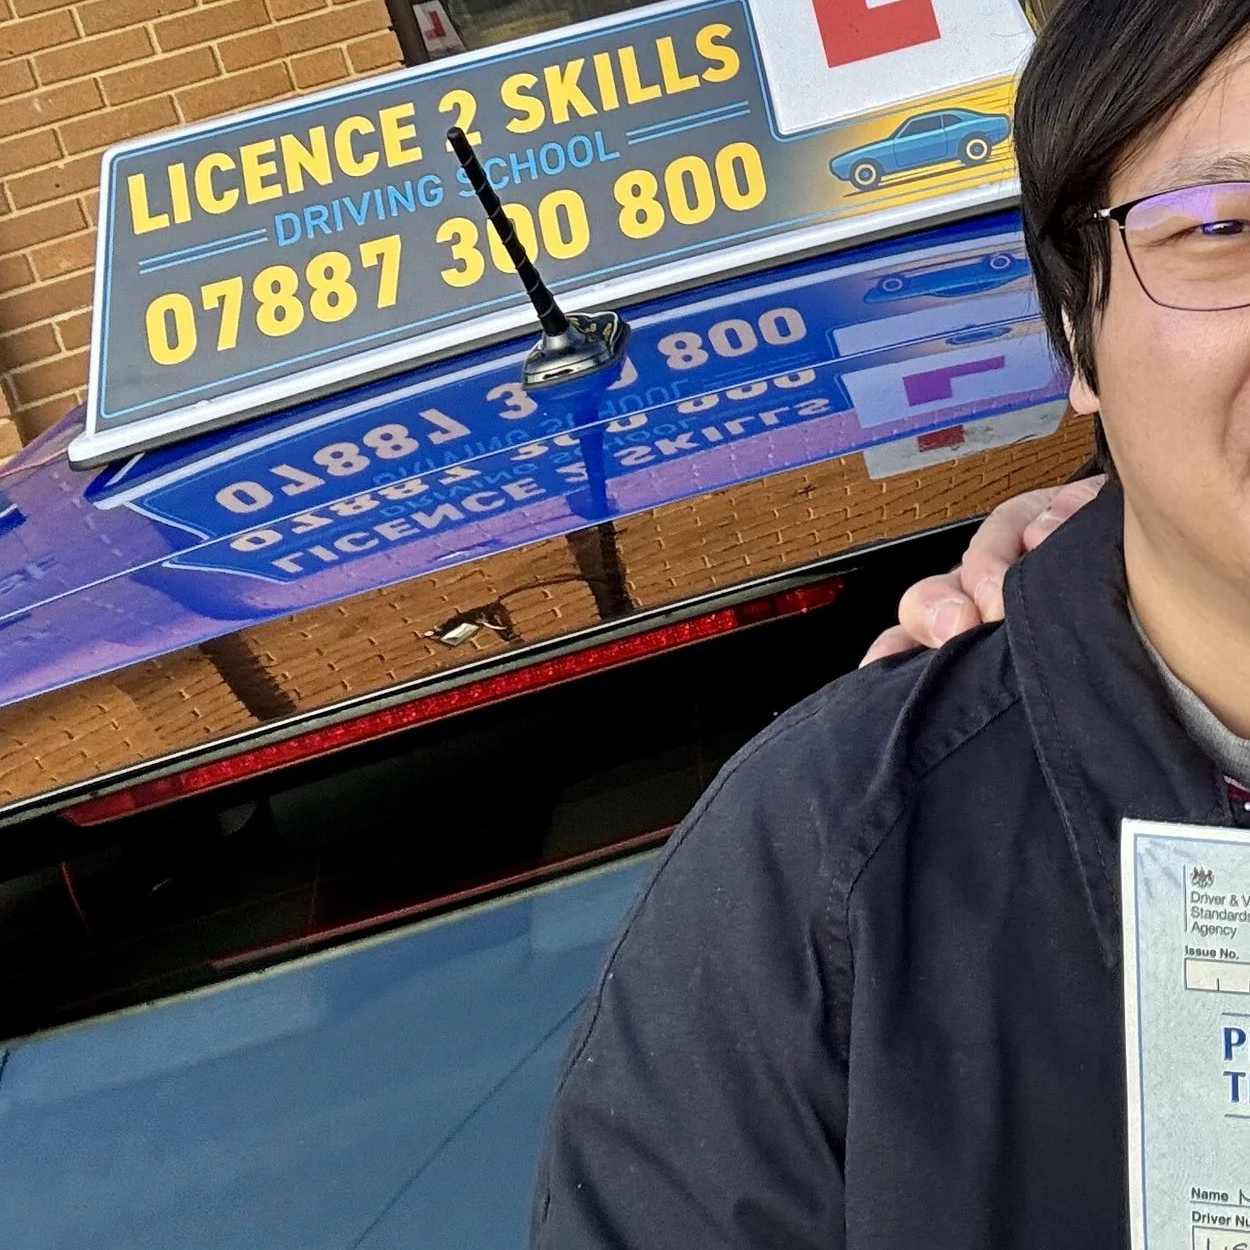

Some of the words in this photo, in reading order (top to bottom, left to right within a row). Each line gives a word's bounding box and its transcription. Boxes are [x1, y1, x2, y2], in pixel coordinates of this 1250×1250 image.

[127, 101, 423, 235] LICENCE
[438, 89, 482, 153] 2
[501, 24, 743, 136] SKILLS
[274, 173, 445, 247] DRIVING
[456, 131, 621, 198] SCHOOL
[145, 234, 402, 366] 07887
[436, 189, 591, 289] 300
[614, 142, 768, 240] 800
[1190, 890, 1226, 906] Driver
[1229, 893, 1240, 908] &
[1191, 921, 1237, 939] Agency
[1184, 944, 1217, 959] Issue
[1219, 947, 1240, 960] No.
[1191, 1187, 1229, 1202] Name
[1191, 1209, 1232, 1227] Driver
